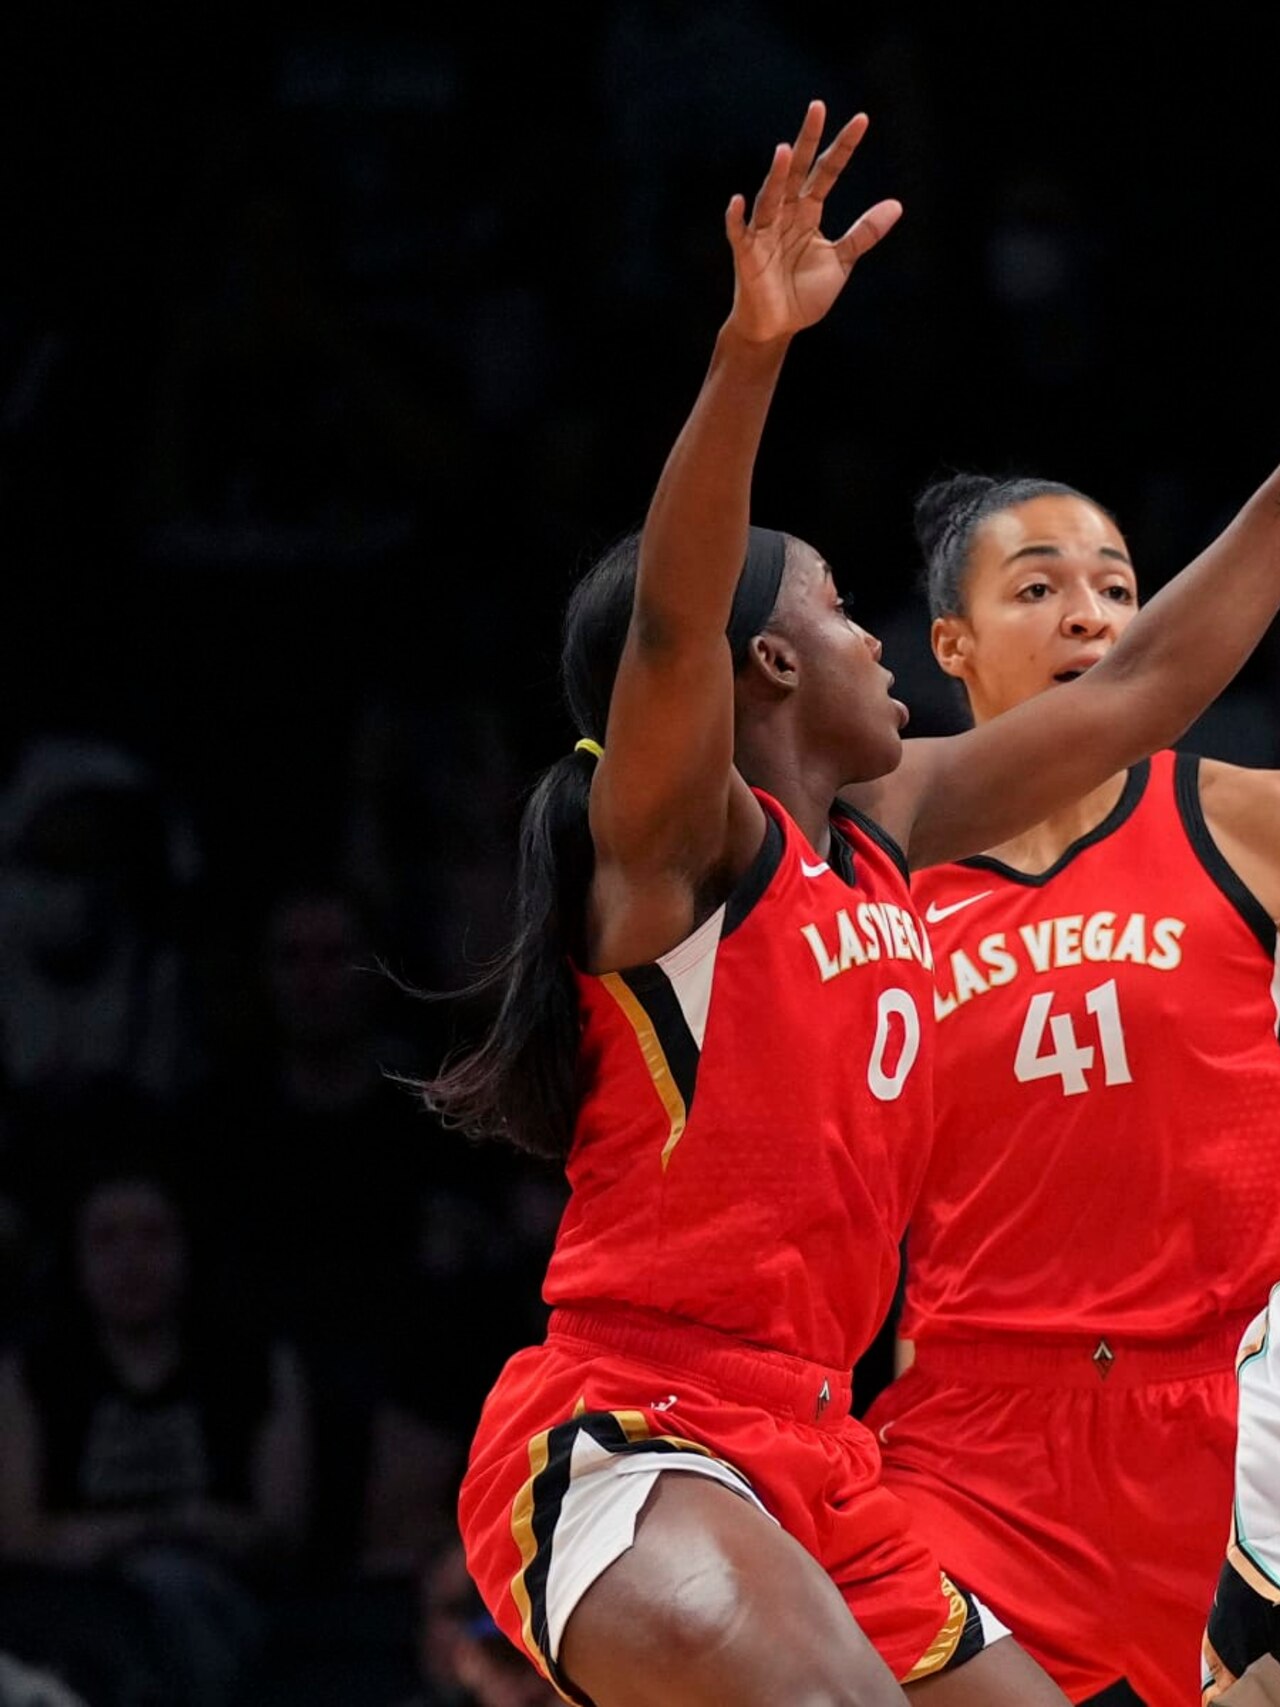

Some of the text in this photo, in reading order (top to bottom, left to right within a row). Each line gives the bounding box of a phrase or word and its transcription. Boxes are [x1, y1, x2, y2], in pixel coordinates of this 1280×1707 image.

[800, 902, 881, 984] LAS
[1017, 911, 1187, 973] VEGAS
[867, 988, 920, 1101] 0
[1013, 978, 1133, 1096] 41
